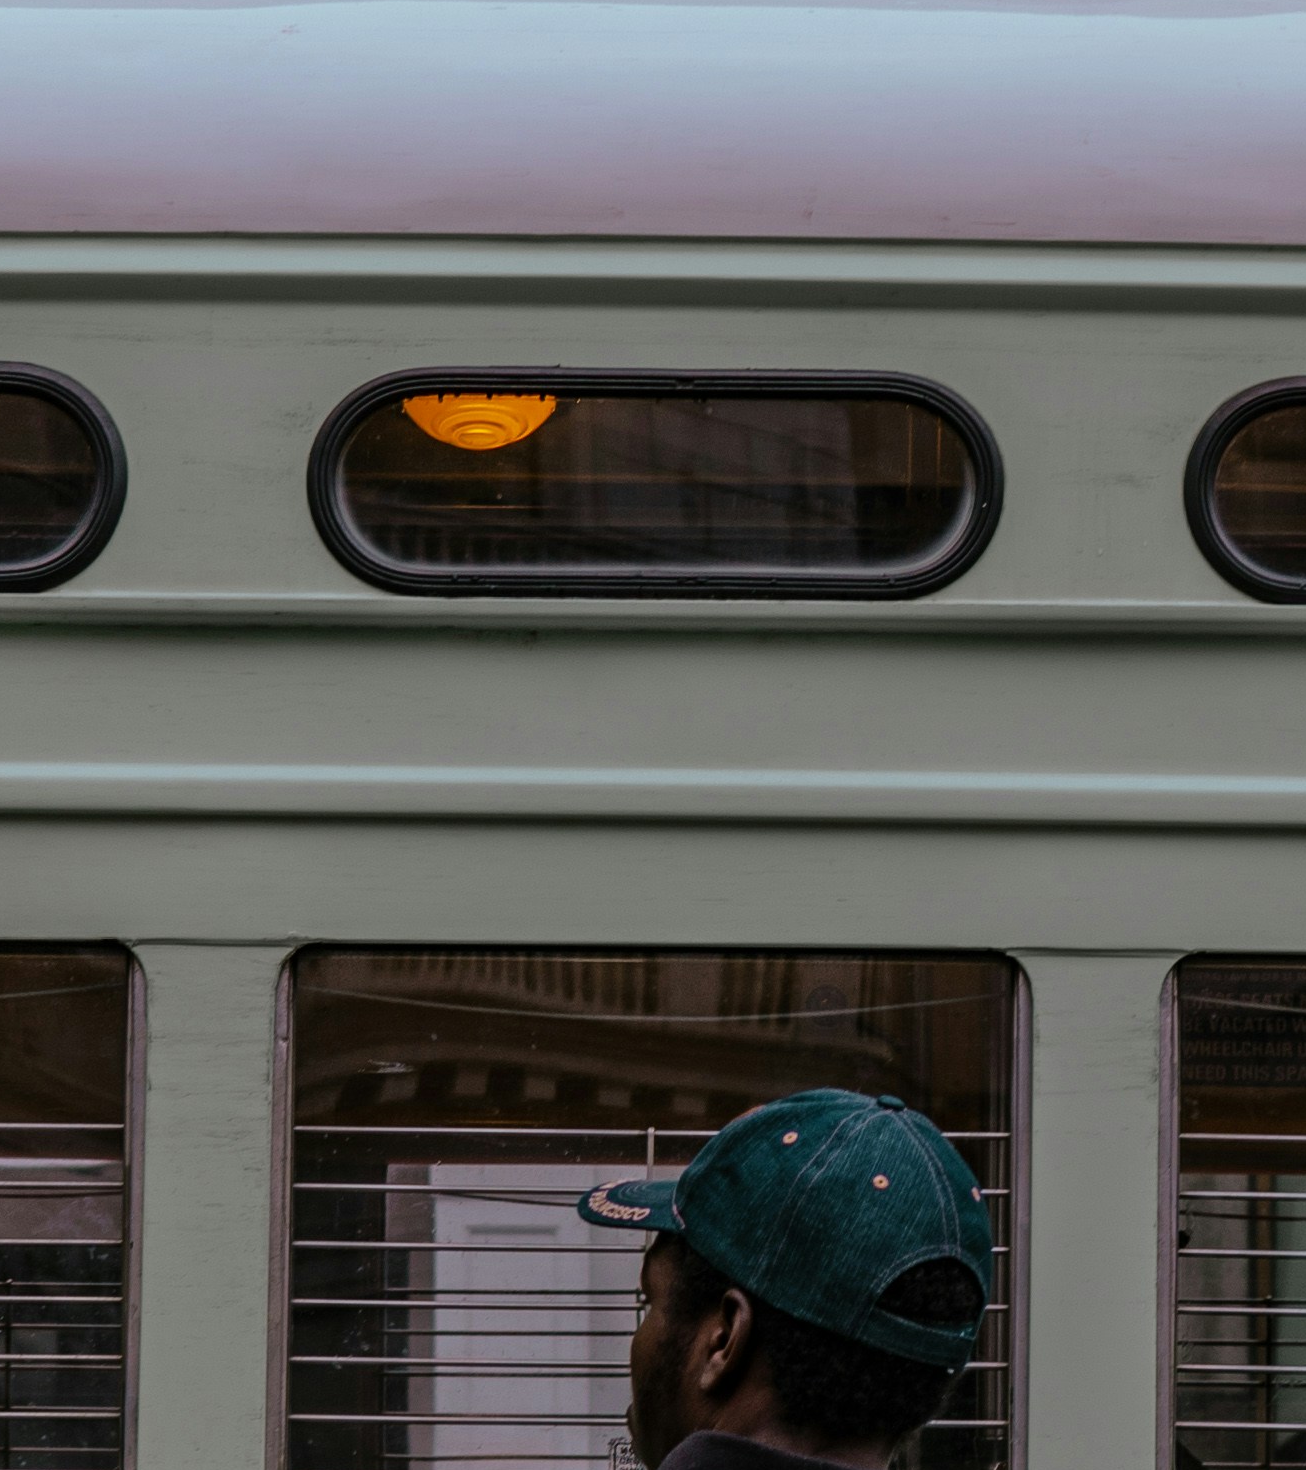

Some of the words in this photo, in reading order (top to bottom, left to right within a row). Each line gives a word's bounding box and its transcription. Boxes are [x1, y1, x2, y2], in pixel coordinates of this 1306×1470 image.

[1209, 1016, 1288, 1034] VACATED
[1182, 1040, 1293, 1058] WHEELCHAIR
[1182, 1063, 1227, 1082] NEED
[1231, 1063, 1270, 1082] THIS
